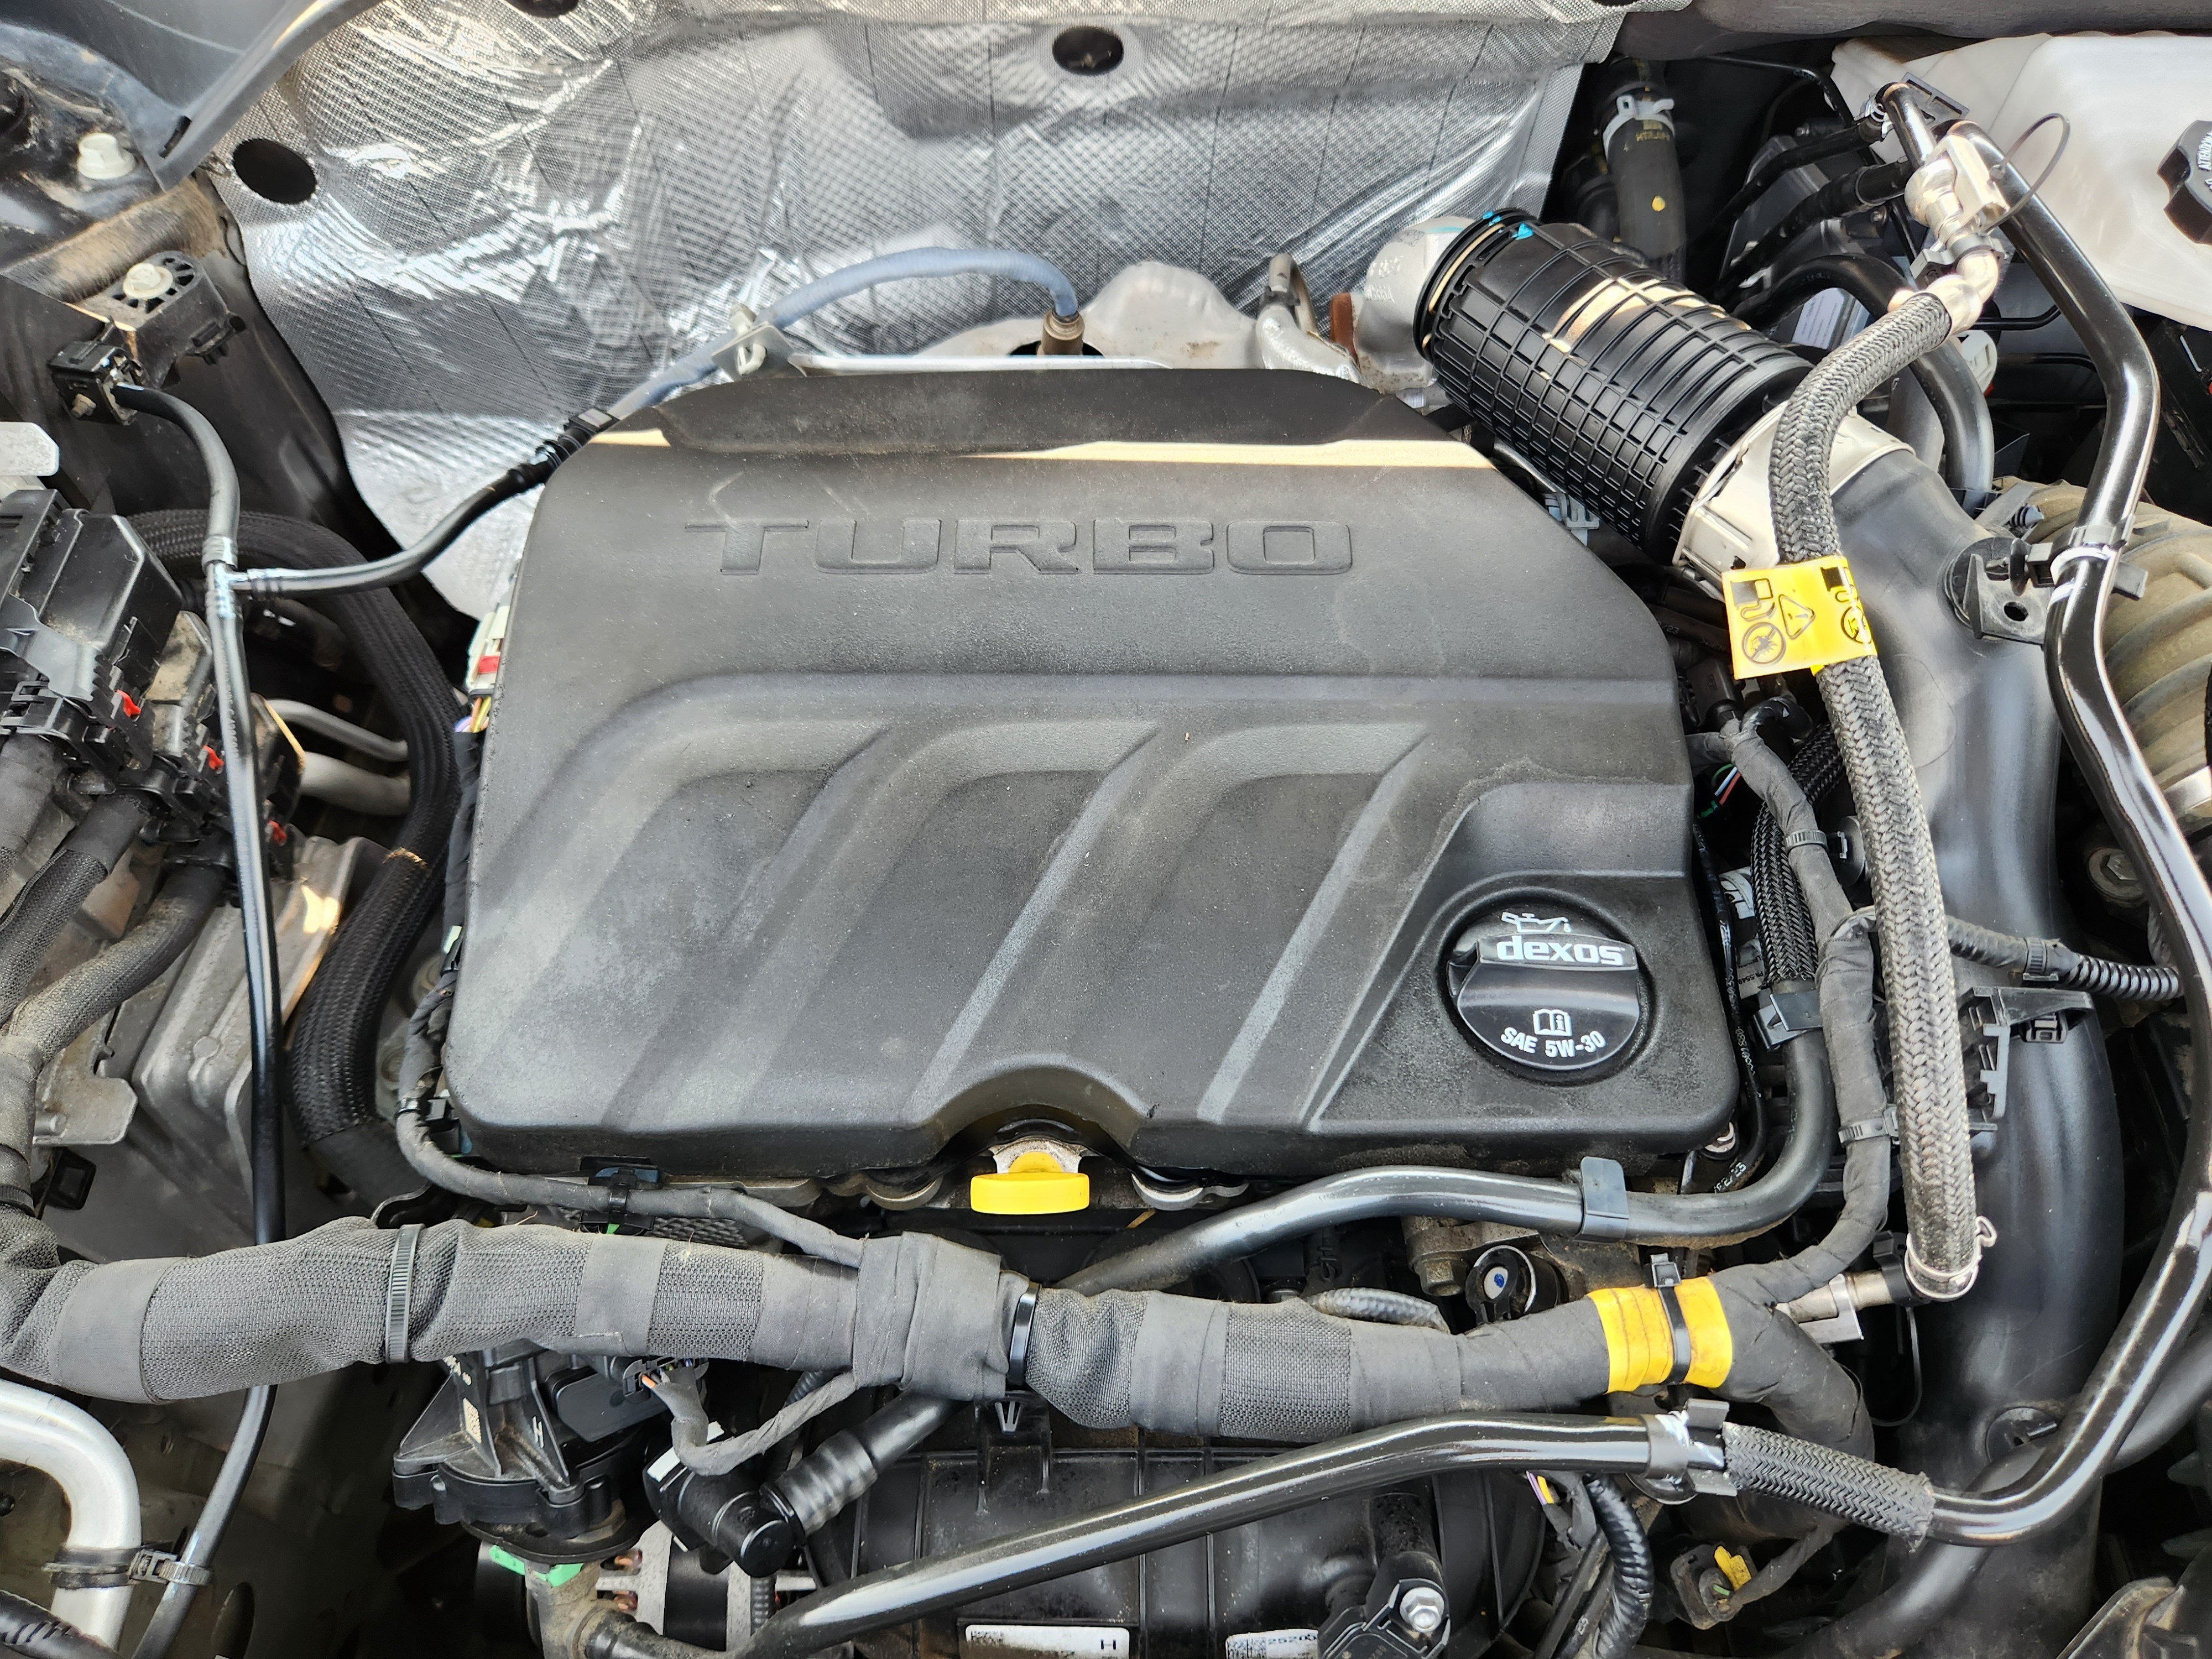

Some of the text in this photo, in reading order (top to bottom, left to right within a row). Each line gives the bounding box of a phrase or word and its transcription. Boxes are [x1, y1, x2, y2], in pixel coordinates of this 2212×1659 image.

[685, 518, 1354, 575] TURBO
[1496, 935, 1624, 966] dexos
[1501, 1027, 1606, 1058] SAE 5W-30
